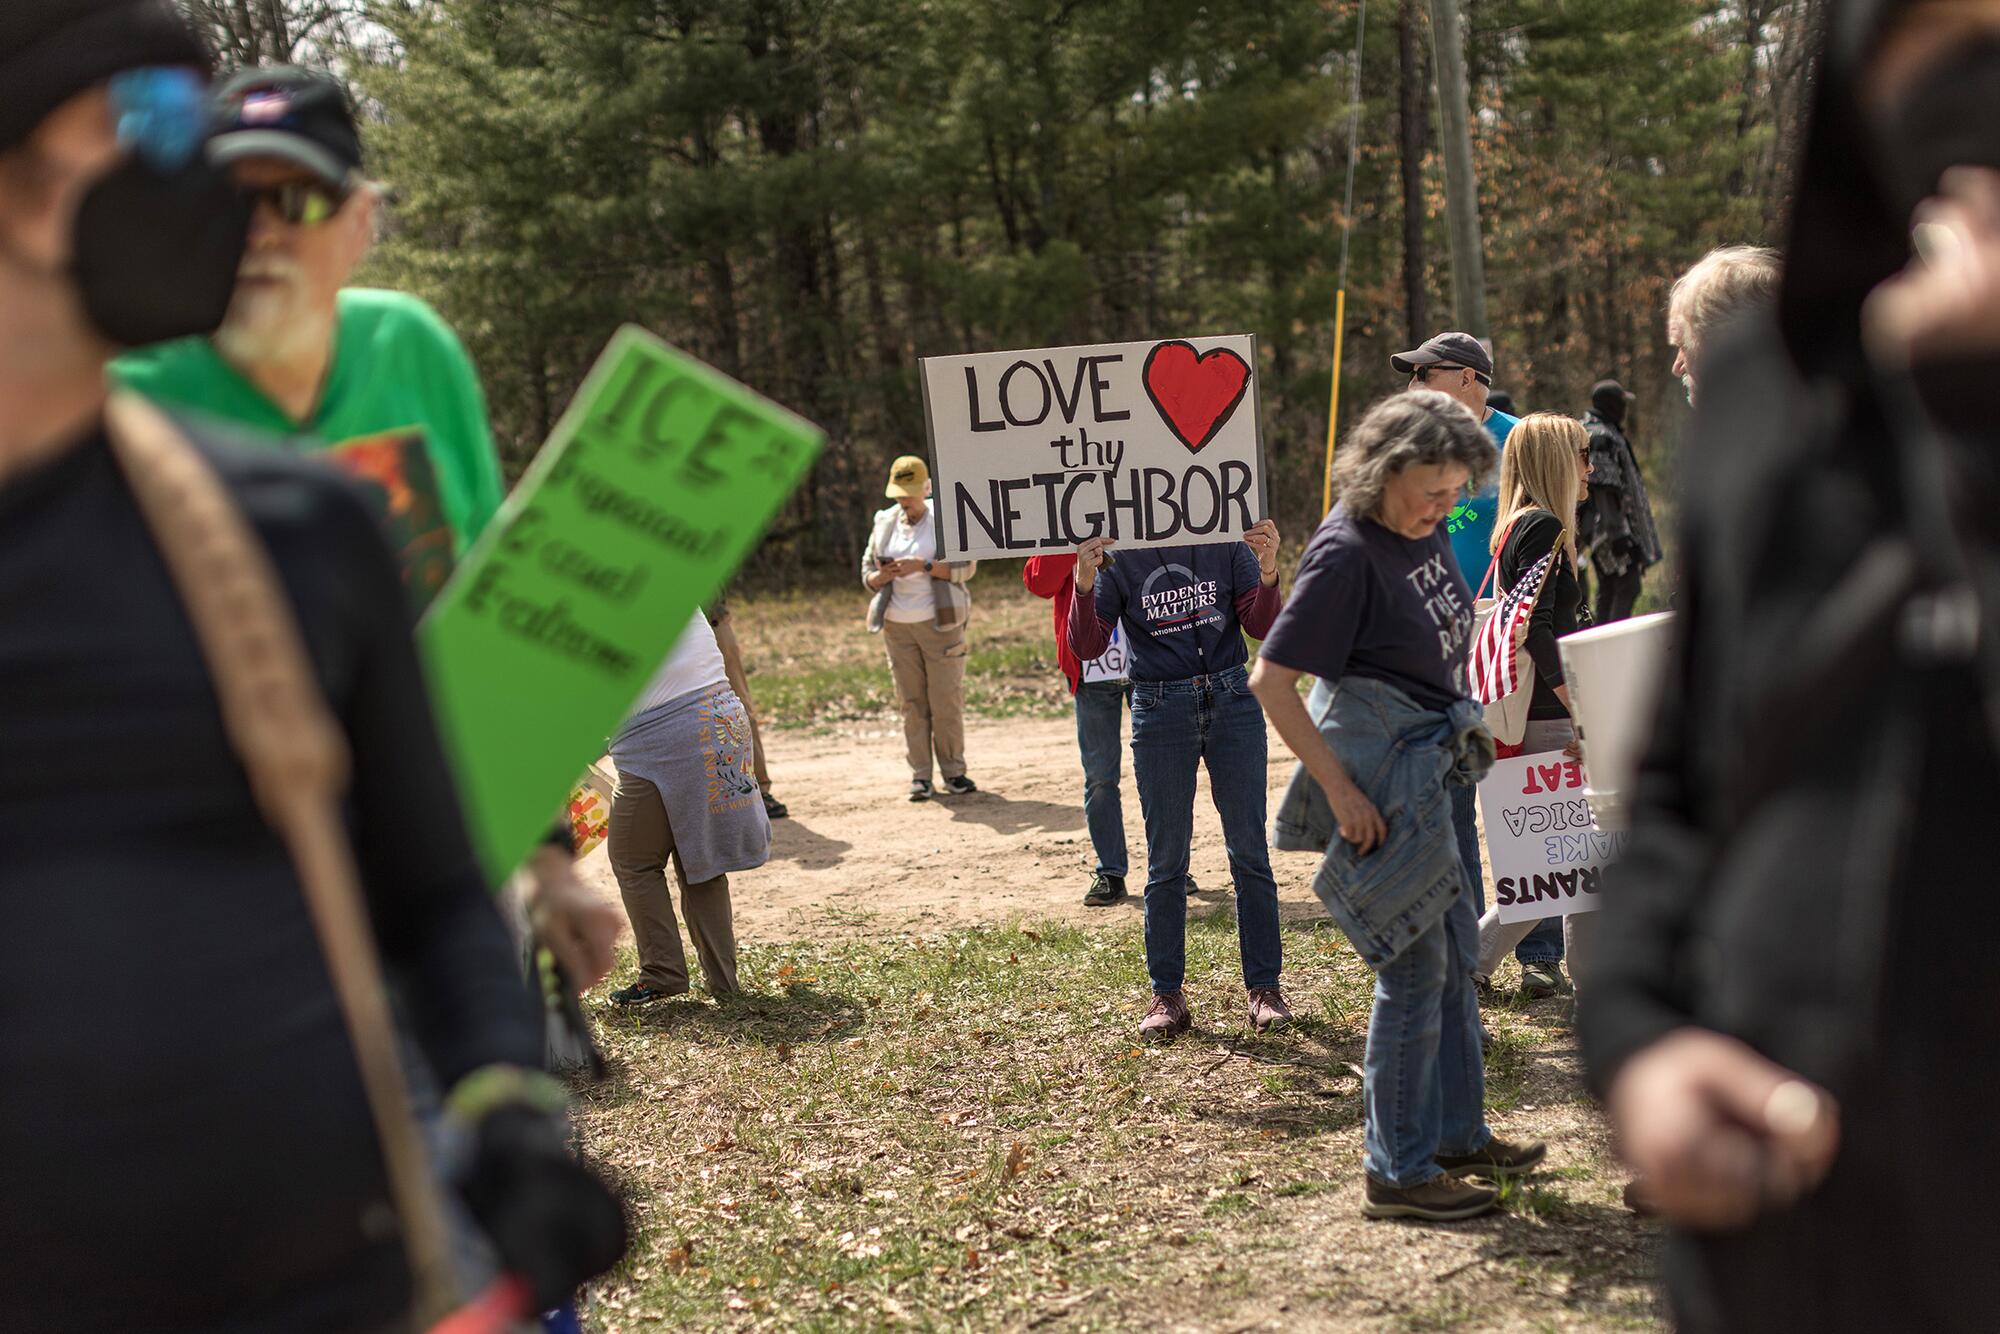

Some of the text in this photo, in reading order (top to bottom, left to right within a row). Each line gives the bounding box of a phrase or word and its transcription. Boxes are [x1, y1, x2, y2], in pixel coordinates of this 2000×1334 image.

[964, 354, 1131, 432] LOVE
[597, 352, 771, 482] ICE
[1050, 427, 1124, 476] thy
[954, 460, 1253, 552] NEIGHBOR
[1447, 519, 1465, 534] et
[1141, 580, 1217, 609] EVIDENCE
[1406, 552, 1448, 597] TAX
[1146, 592, 1217, 621] MATTERS
[1182, 618, 1208, 631] HISORY
[1424, 582, 1462, 626] THE
[1438, 607, 1473, 661] RICH
[1522, 761, 1586, 795] EAT
[1503, 799, 1594, 837] RICA
[1497, 866, 1606, 906] RANTS
